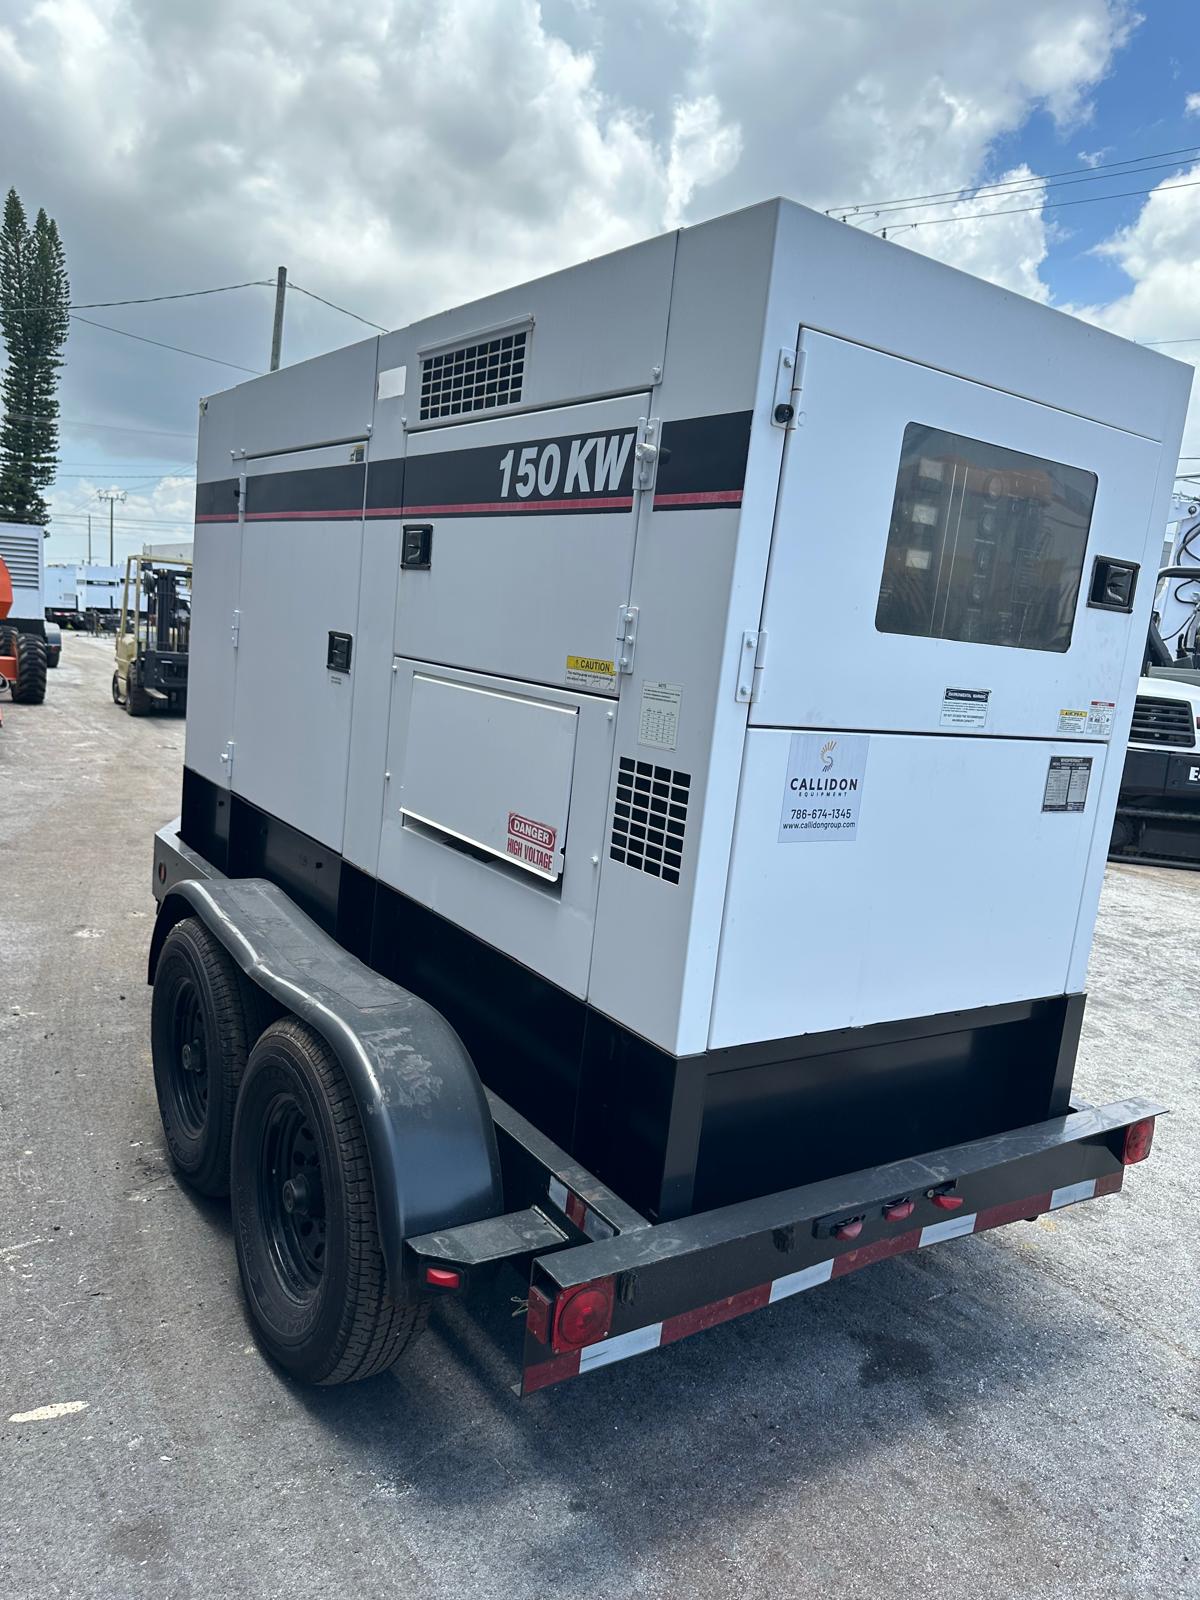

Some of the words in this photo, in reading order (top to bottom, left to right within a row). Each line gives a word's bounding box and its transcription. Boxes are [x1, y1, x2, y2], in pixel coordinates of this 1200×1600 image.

[499, 443, 561, 498] 150
[563, 433, 635, 494] KW
[580, 659, 610, 672] CAUTION
[1188, 766, 1200, 782] E
[790, 778, 858, 791] CALLIDON
[791, 808, 852, 819] 786-674-1345
[513, 820, 550, 844] DANGER
[783, 821, 856, 830] www.callidongroup.com
[507, 837, 523, 858] HIGH
[524, 844, 553, 871] VOLTAGE
